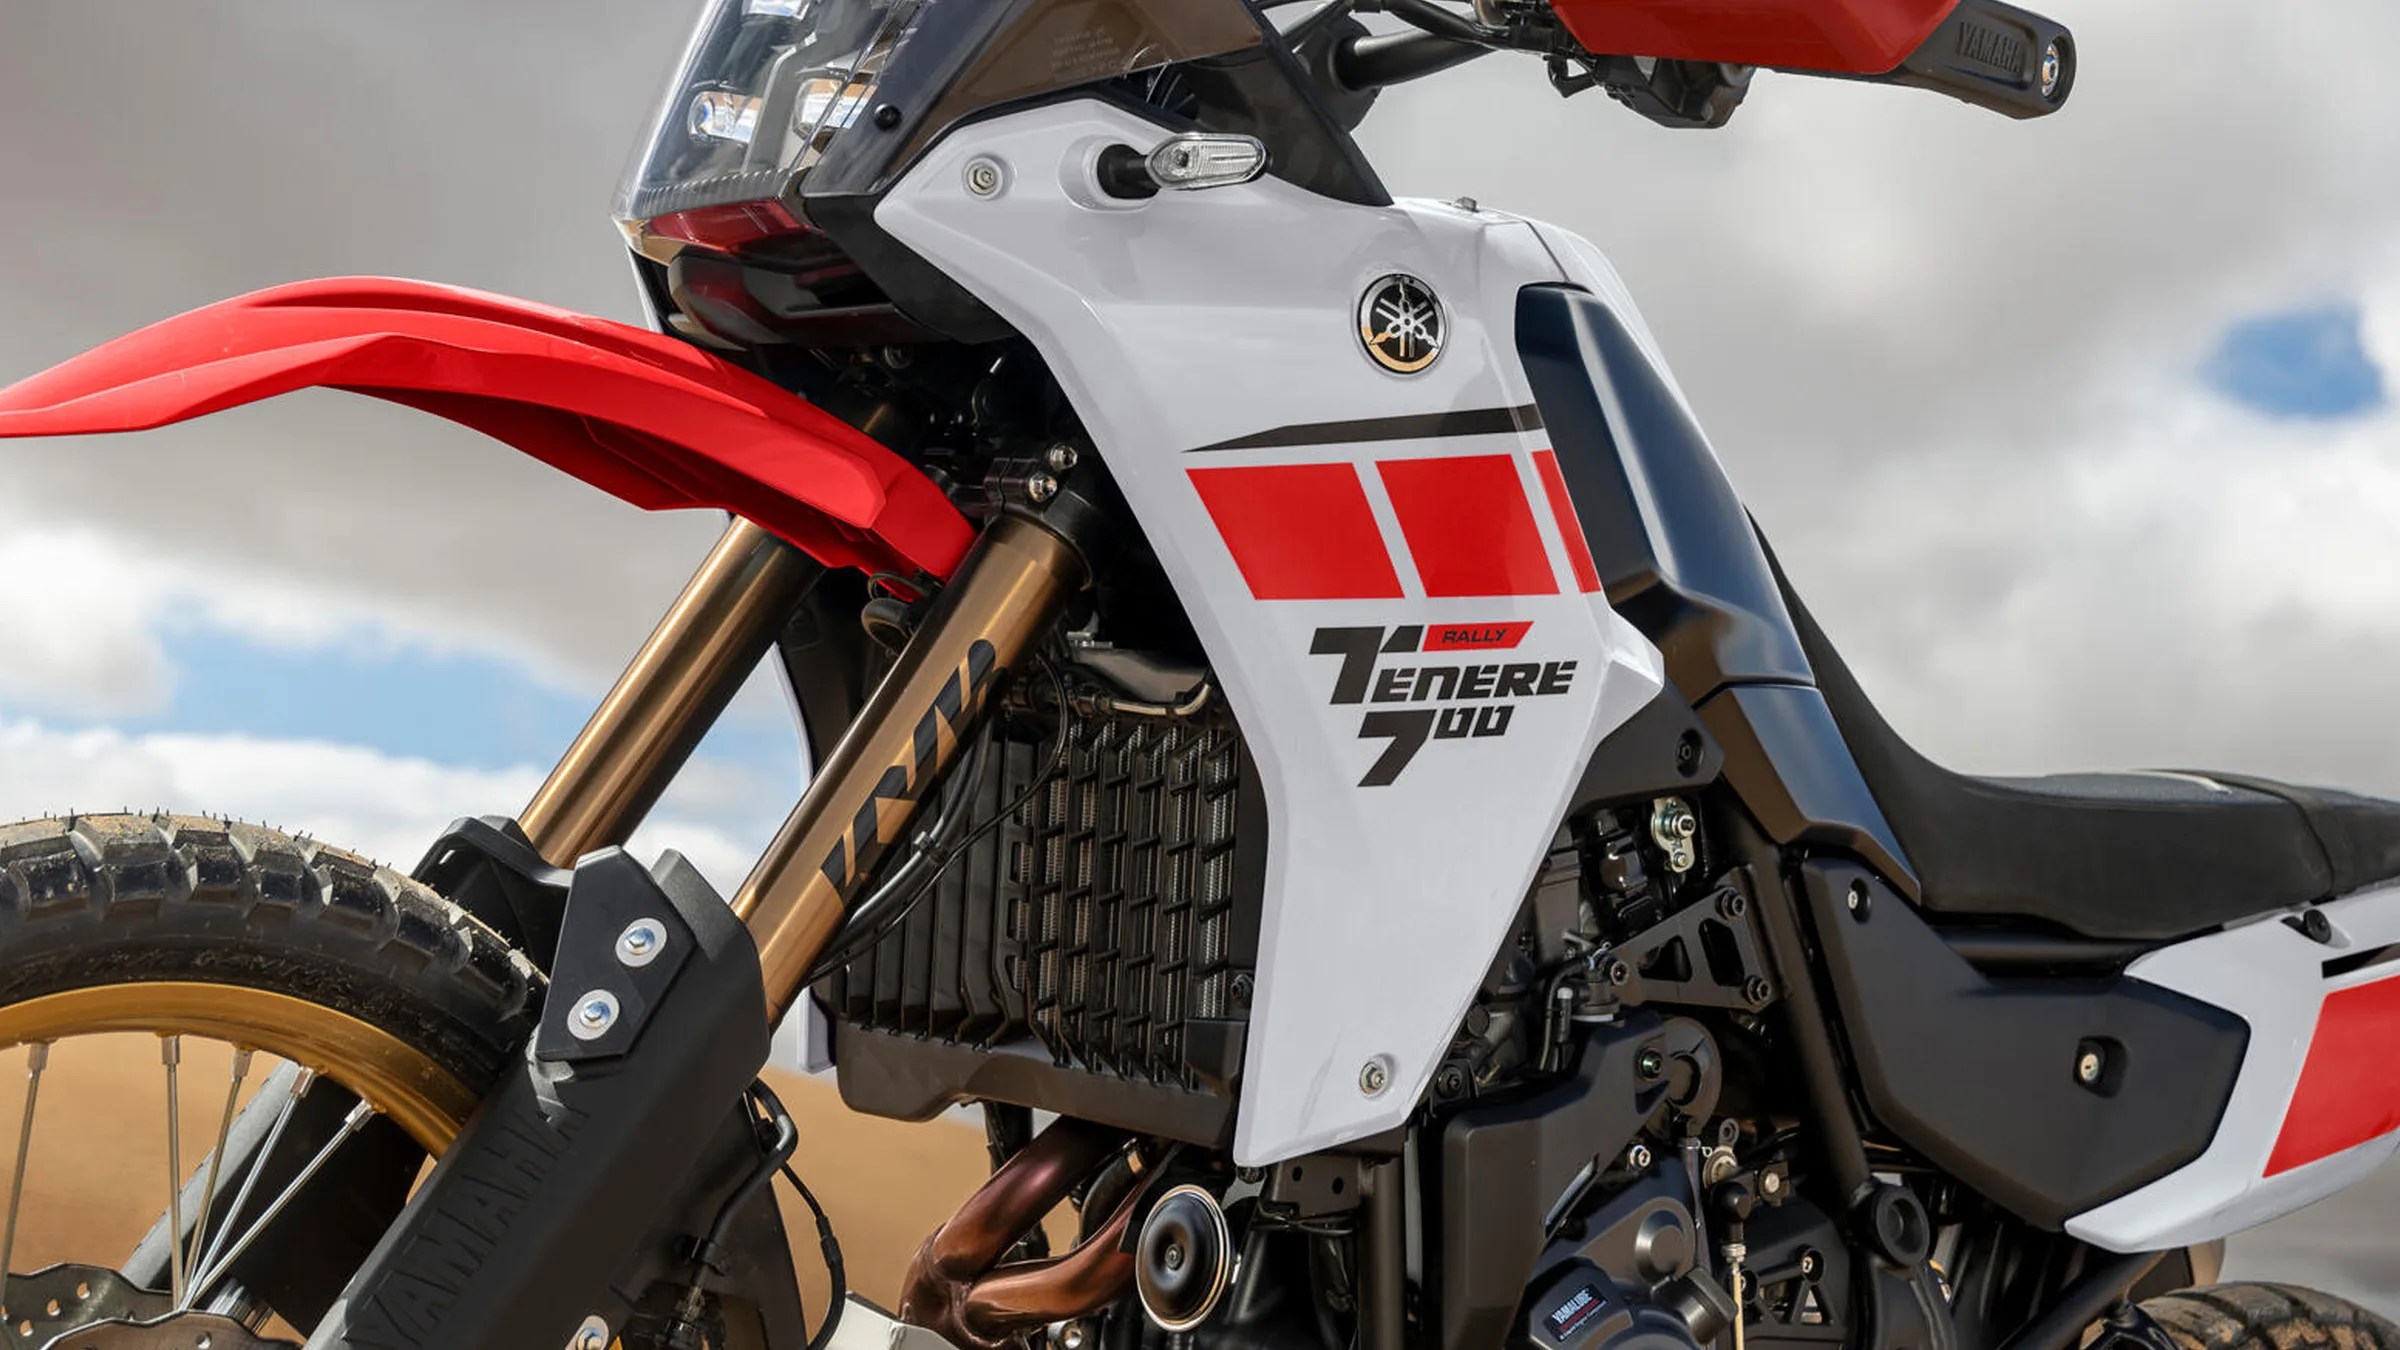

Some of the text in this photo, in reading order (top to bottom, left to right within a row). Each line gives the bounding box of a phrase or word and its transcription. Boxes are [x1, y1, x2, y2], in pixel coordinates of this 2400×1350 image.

[1957, 21, 2024, 73] YAMAHA
[1442, 628, 1507, 643] RALLY
[1357, 705, 1515, 787] 700
